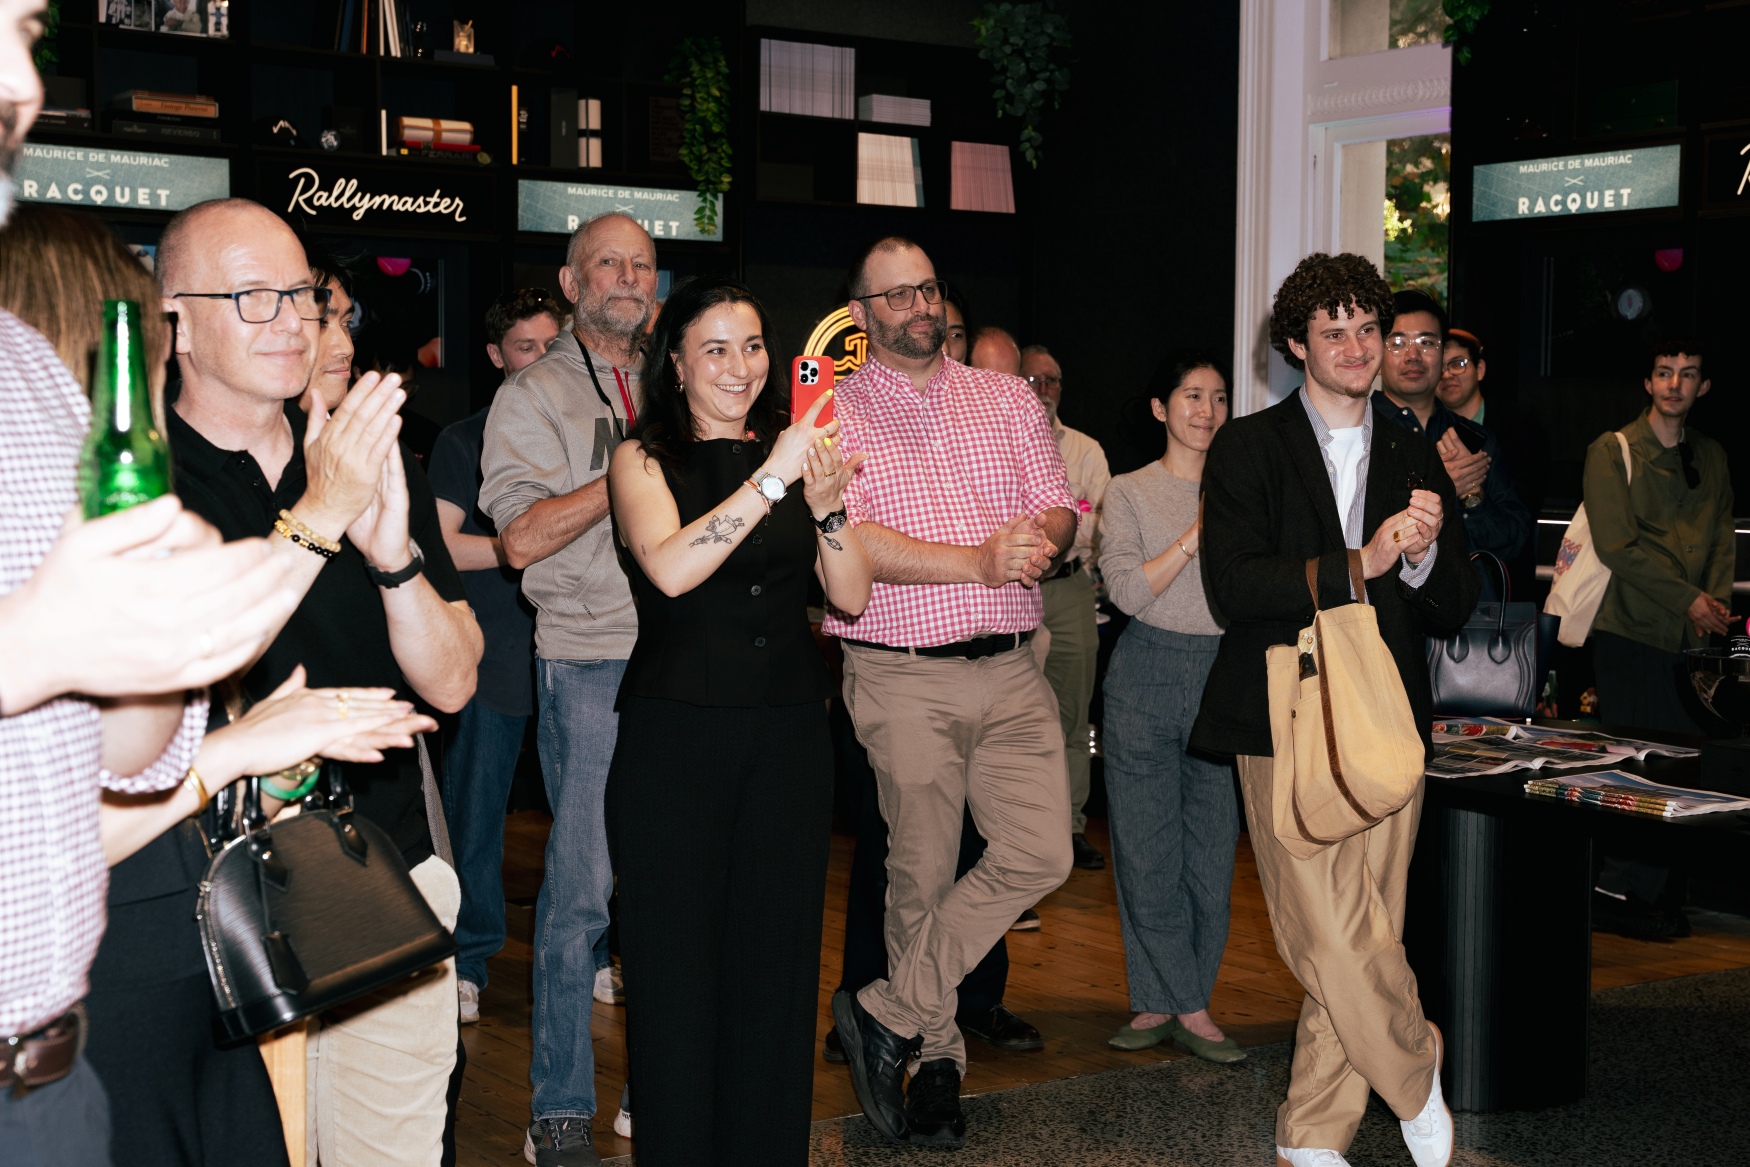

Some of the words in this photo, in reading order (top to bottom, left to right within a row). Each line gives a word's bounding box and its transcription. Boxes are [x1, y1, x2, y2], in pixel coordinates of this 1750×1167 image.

[23, 147, 84, 161] MAURICE
[89, 152, 106, 162] DE
[110, 154, 169, 167] MAURIAC
[1519, 162, 1565, 174] MAURICE
[1568, 160, 1581, 170] DE
[1584, 154, 1632, 168] MAURIAC
[23, 179, 170, 206] RACQUET
[288, 167, 467, 222] Rallymaster
[567, 187, 614, 198] MAURICE
[618, 190, 631, 198] DE
[634, 191, 680, 202] MAURIAC
[1518, 188, 1632, 215] RACQUET
